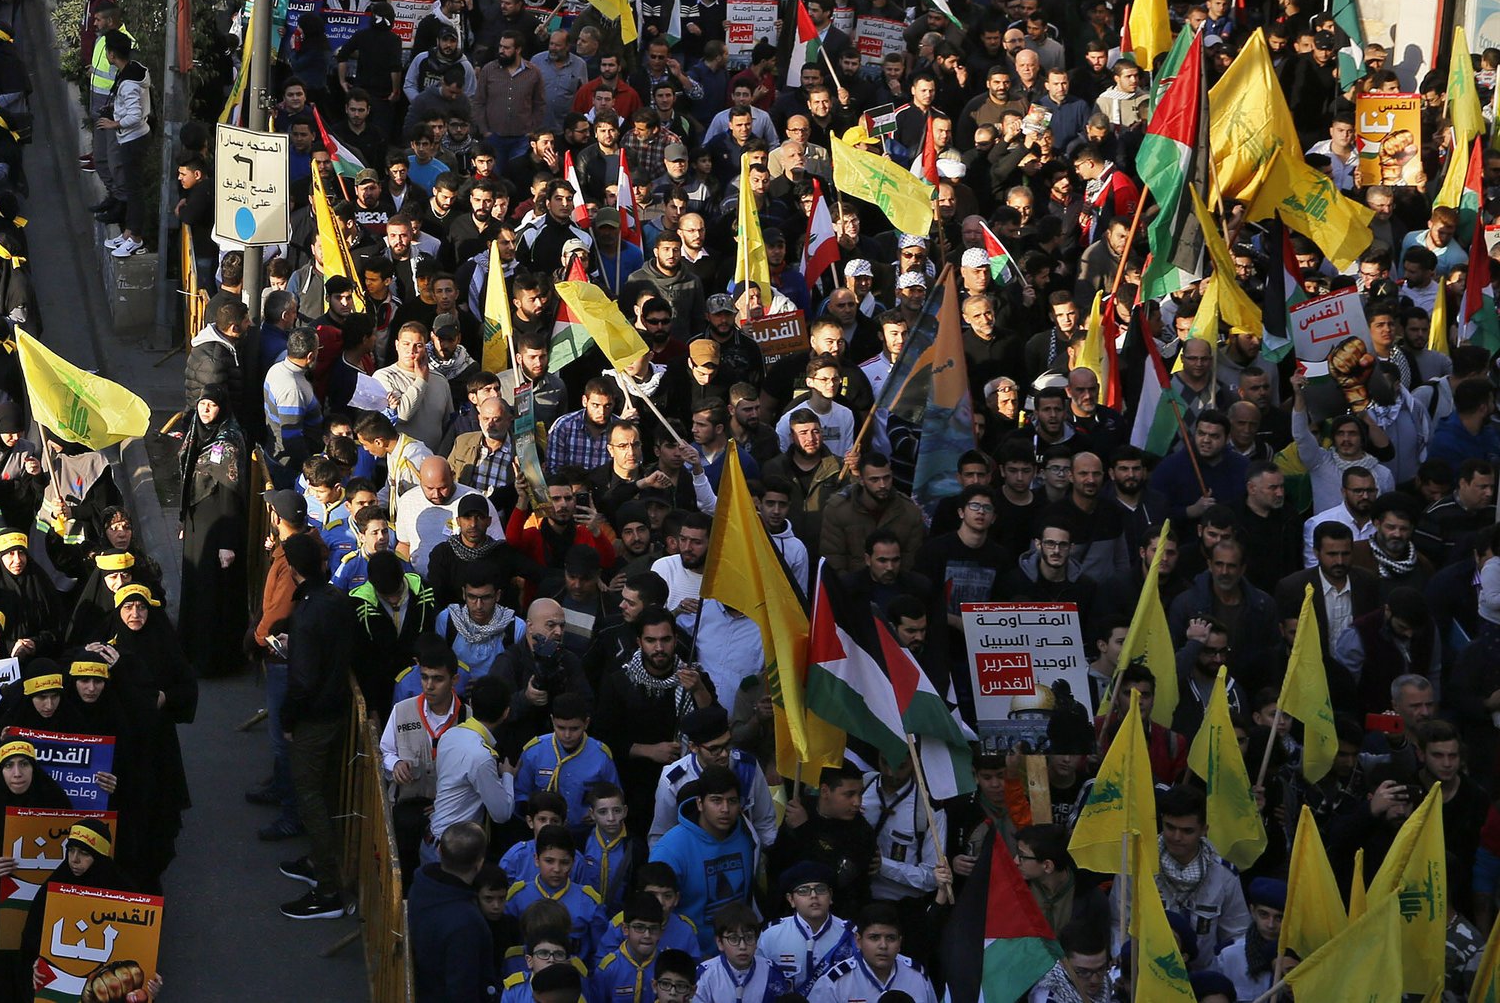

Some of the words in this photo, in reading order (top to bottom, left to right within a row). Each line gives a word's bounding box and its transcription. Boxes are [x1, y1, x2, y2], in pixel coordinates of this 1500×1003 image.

[287, 2, 315, 12] القدس
[396, 2, 432, 10] المقاومة
[733, 5, 775, 13] المقاومة
[327, 15, 359, 25] القدس
[732, 14, 755, 22] السبيل
[731, 25, 753, 33] لتحرير
[754, 25, 774, 34] الوحيد
[862, 29, 885, 38] السبيل
[729, 34, 753, 43] القدس
[860, 38, 883, 46] لتحرير
[860, 47, 881, 56] القدس
[1378, 101, 1416, 112] القدس
[1360, 111, 1395, 134] لنا
[247, 140, 282, 154] المتجه
[222, 178, 247, 190] الطريق
[250, 183, 276, 196] افسح
[252, 199, 271, 209] على
[1300, 300, 1345, 330] القدس
[1310, 321, 1350, 344] لنا
[976, 613, 1071, 628] المقاومة
[980, 634, 1030, 649] السبيل
[1035, 635, 1074, 648] هي
[983, 655, 1029, 672] لتحرير
[1033, 656, 1077, 671] الوحيد
[981, 676, 1033, 695] القدس
[397, 721, 422, 733] PRESS
[90, 907, 156, 927] القدس
[50, 917, 120, 963] لنا
